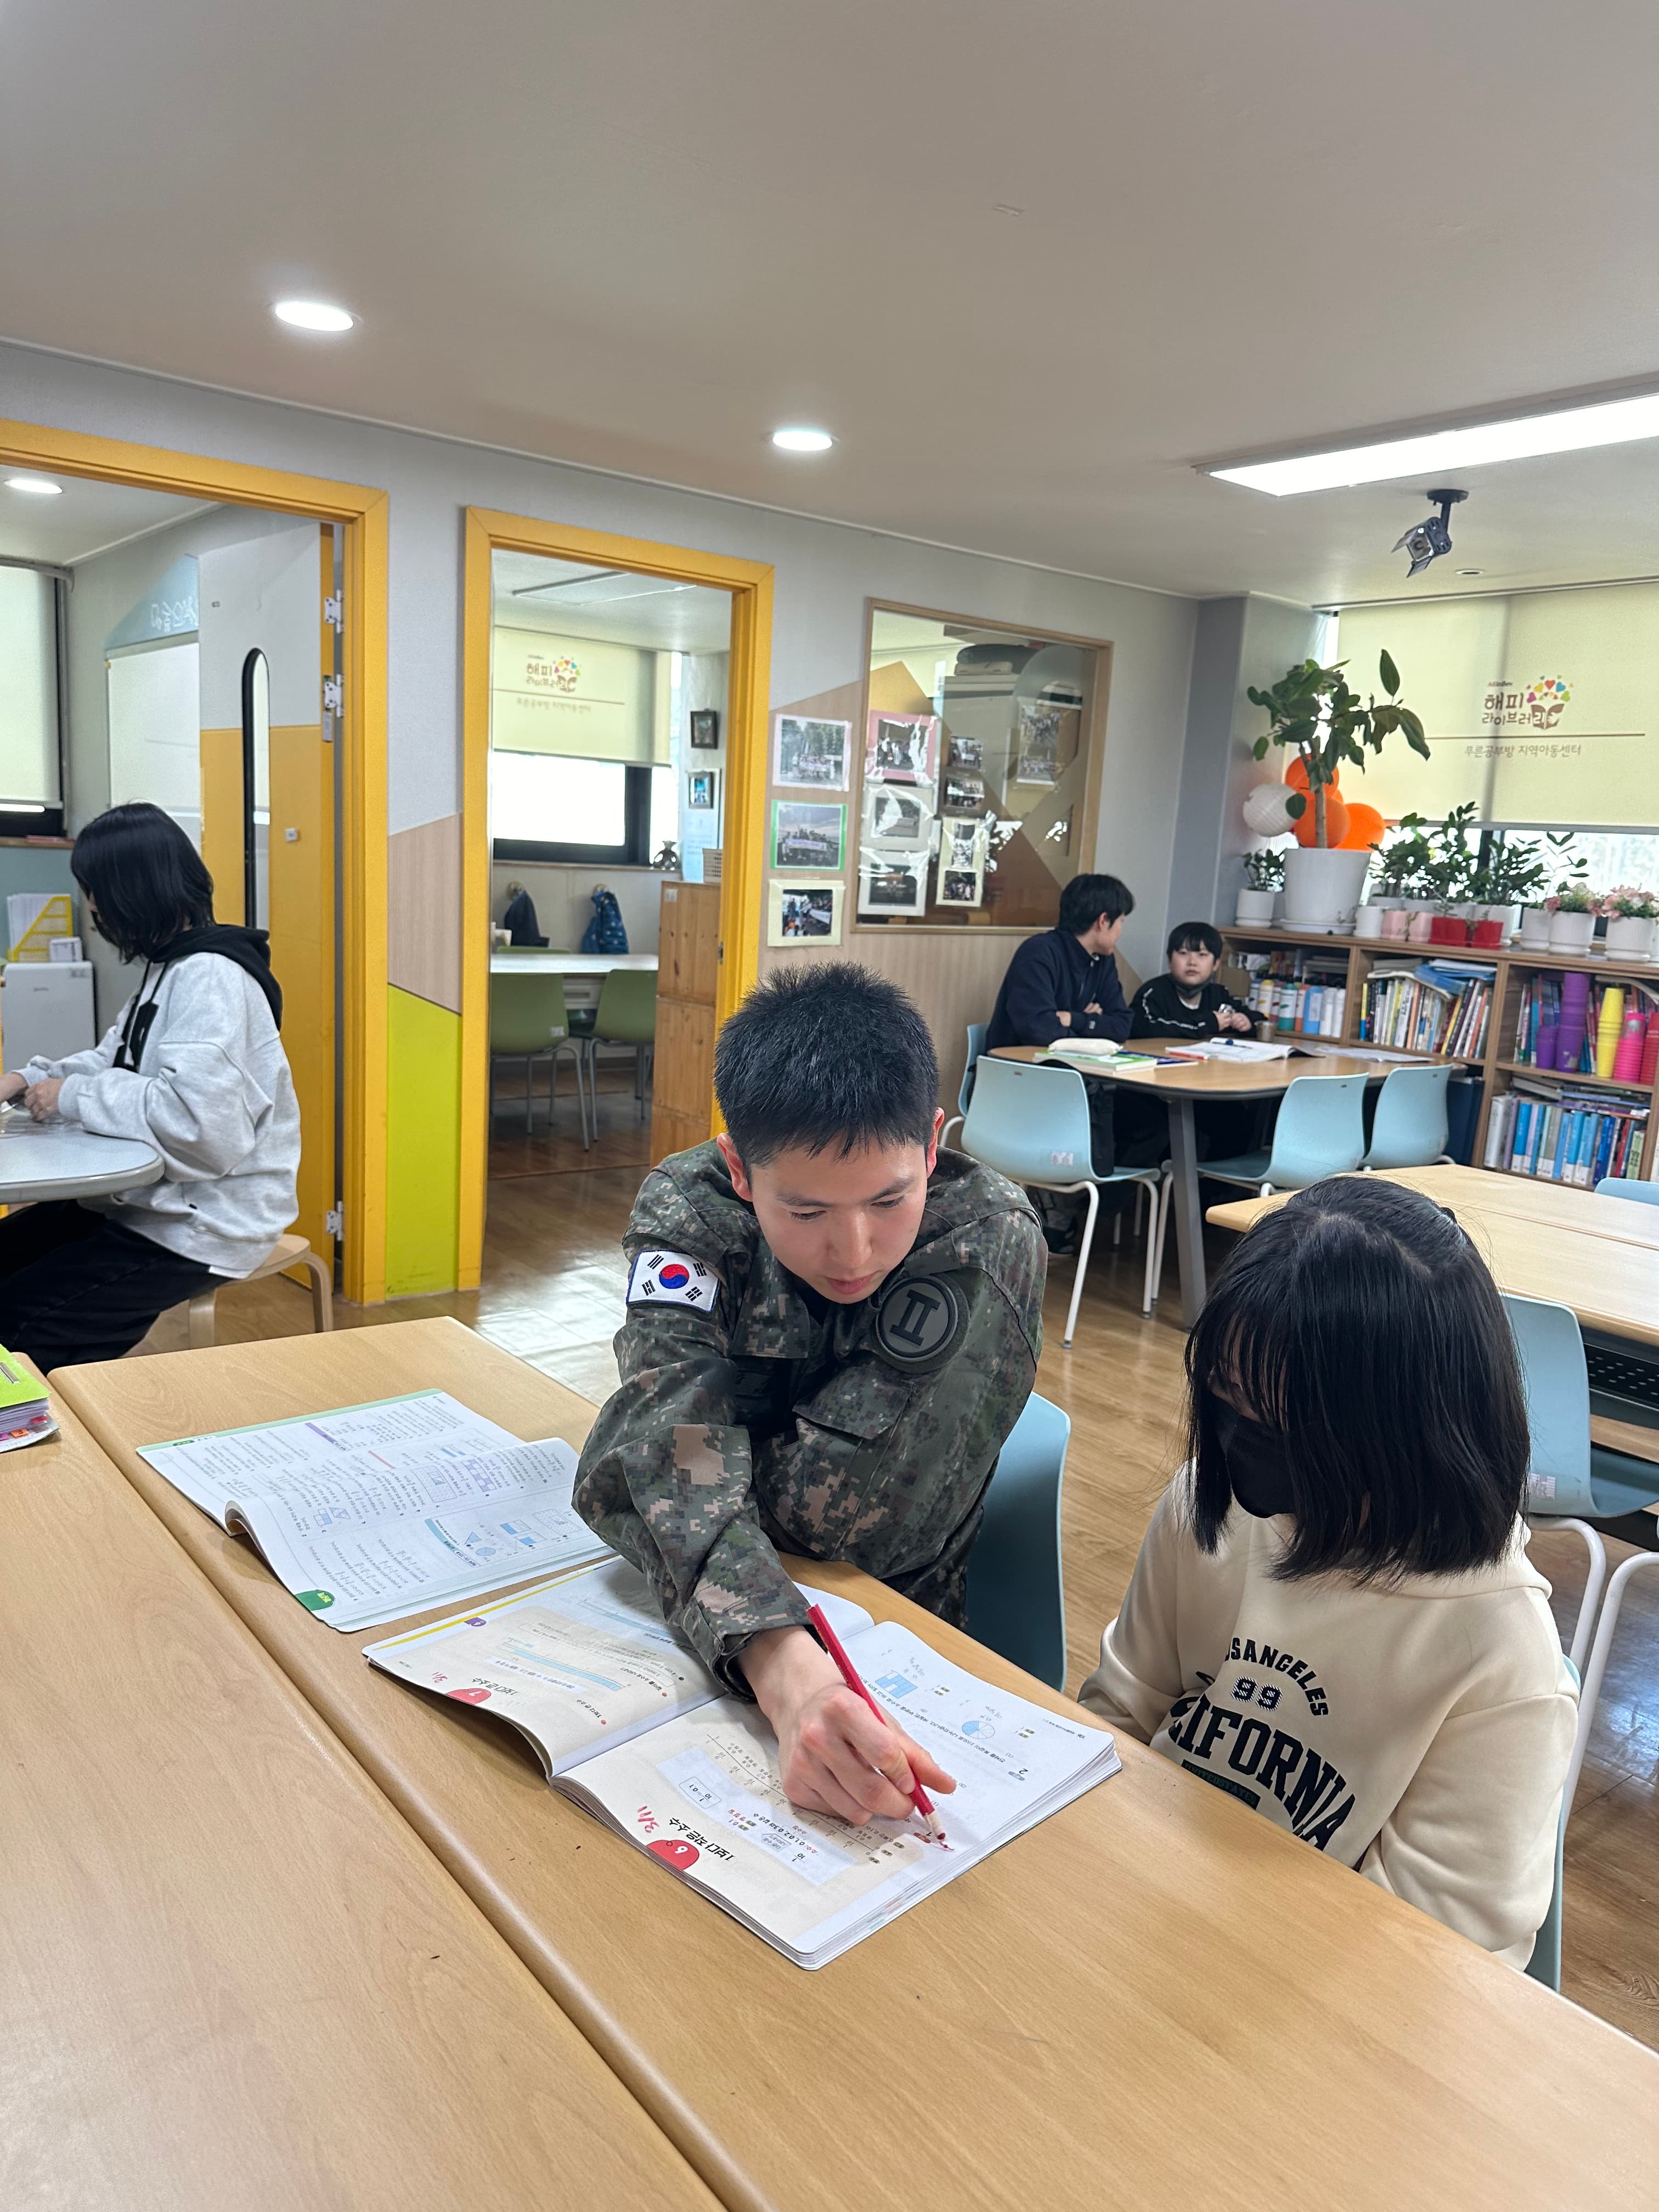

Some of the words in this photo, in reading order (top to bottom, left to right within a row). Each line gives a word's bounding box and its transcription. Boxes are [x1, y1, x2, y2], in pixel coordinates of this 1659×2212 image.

[526, 662, 552, 676] 해피
[1484, 691, 1523, 710] 해피
[1481, 711, 1546, 726] 라이브러리
[1465, 744, 1515, 759] 푸른공부방
[1517, 744, 1581, 758] 지역아동센터
[1231, 1676, 1283, 1712] 99
[1169, 1691, 1356, 1851] IFORNIA
[669, 1818, 690, 1831] 소수
[686, 1831, 708, 1846] 작은
[675, 1845, 689, 1854] 6
[705, 1843, 735, 1861] 1보다
